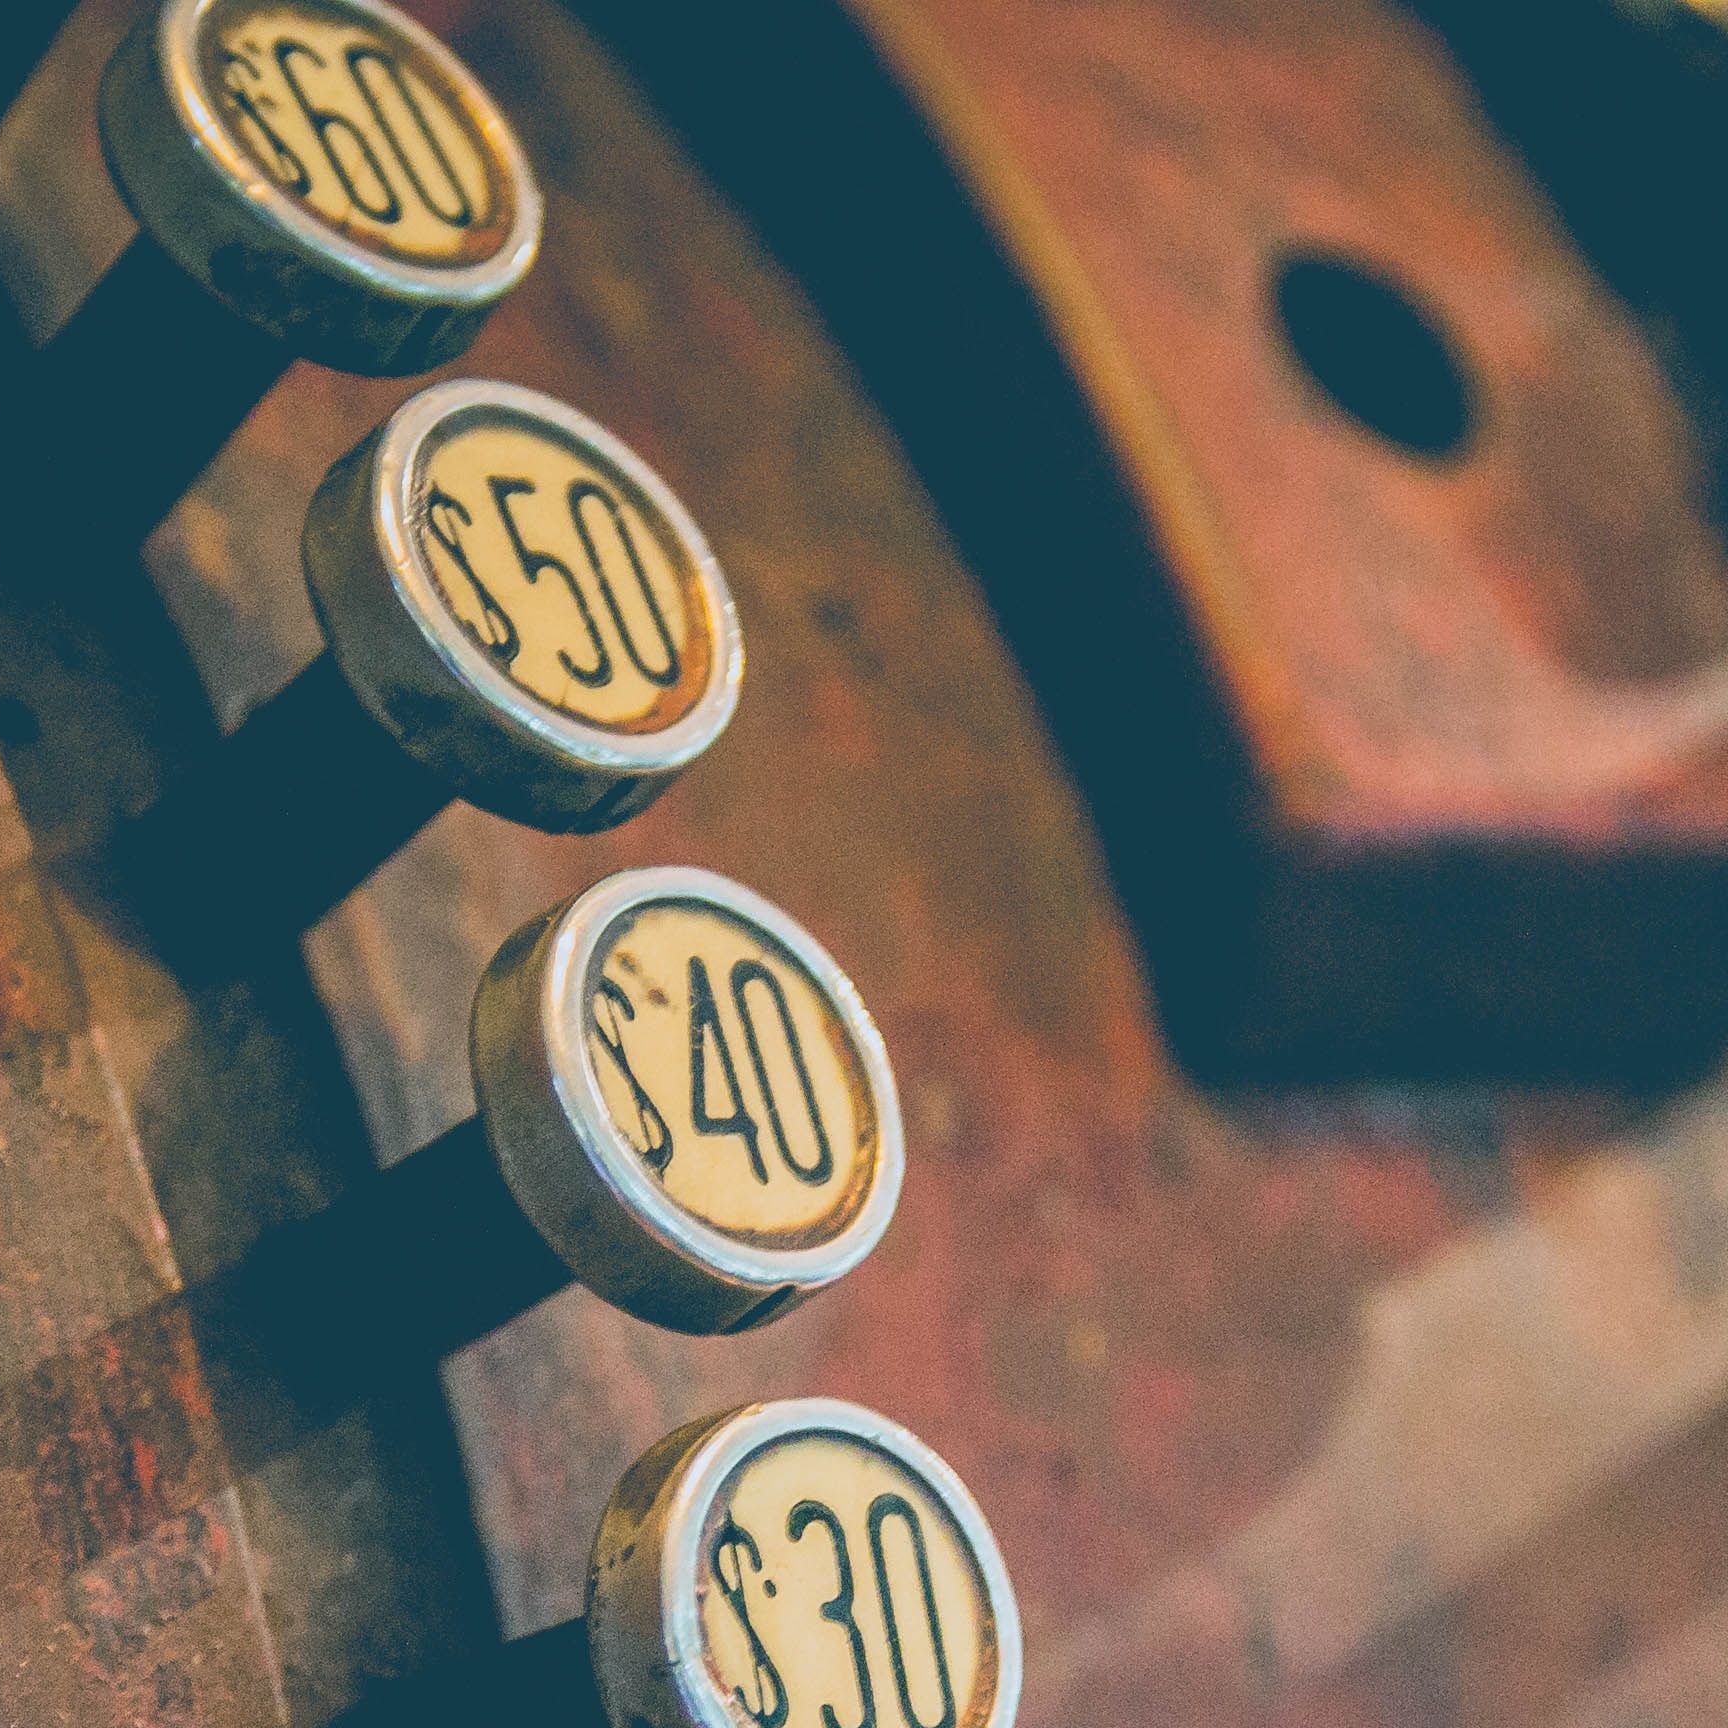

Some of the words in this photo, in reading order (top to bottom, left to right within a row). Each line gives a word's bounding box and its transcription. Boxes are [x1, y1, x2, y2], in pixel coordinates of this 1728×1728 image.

[217, 37, 472, 229] $60
[426, 477, 680, 688] $50
[589, 955, 833, 1187] $40
